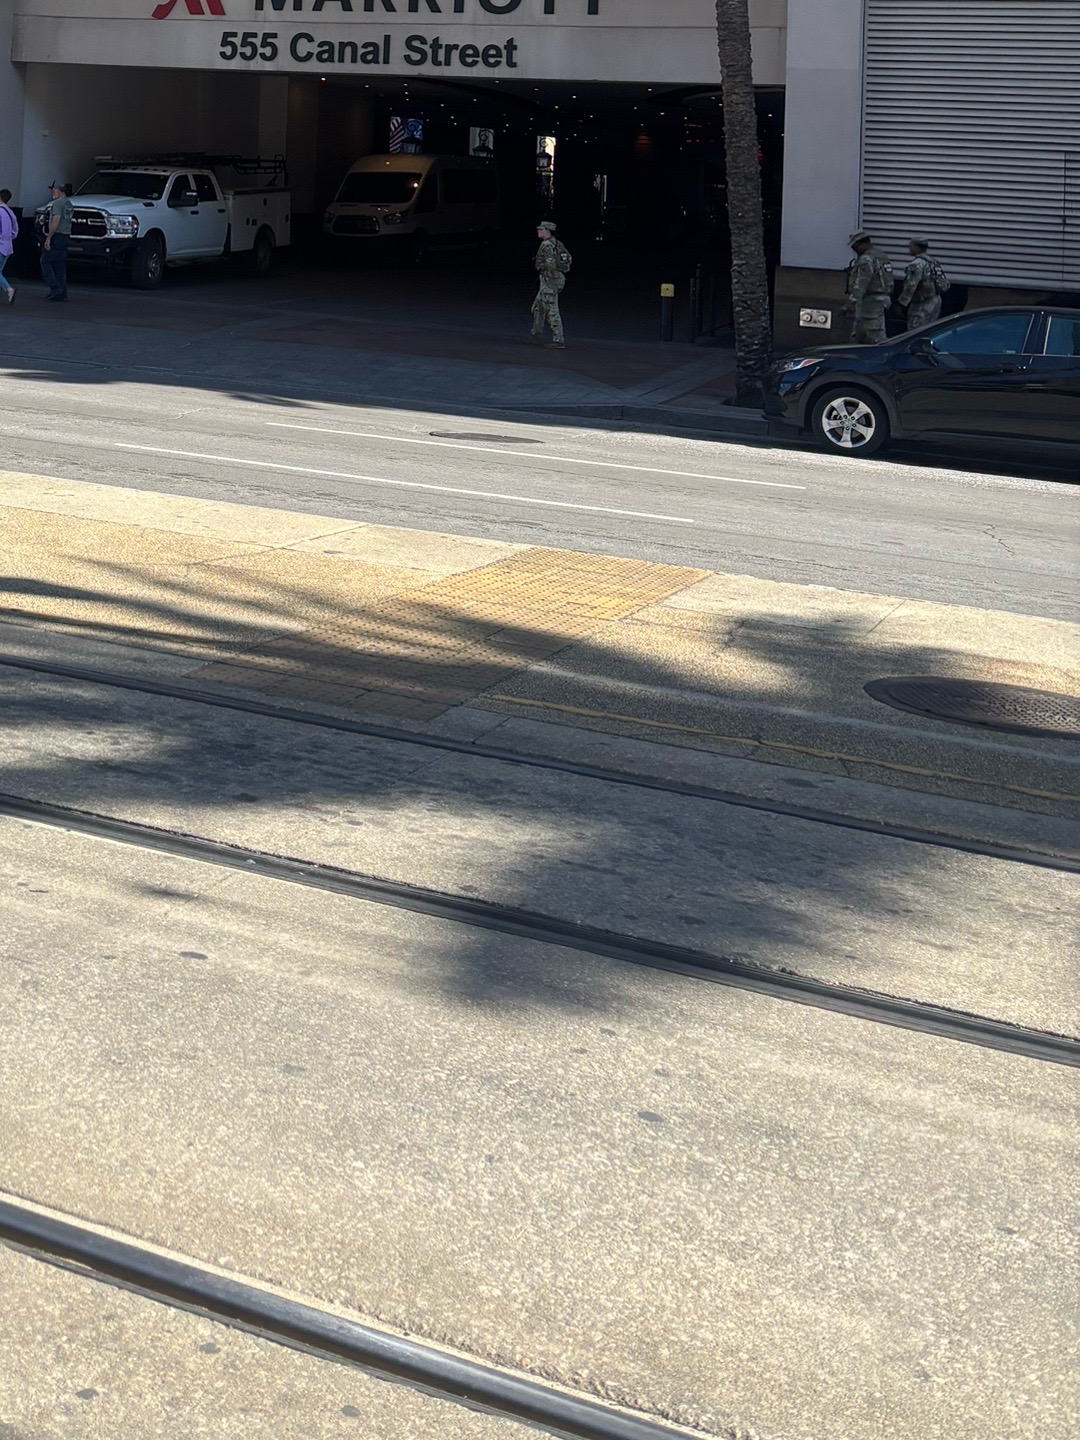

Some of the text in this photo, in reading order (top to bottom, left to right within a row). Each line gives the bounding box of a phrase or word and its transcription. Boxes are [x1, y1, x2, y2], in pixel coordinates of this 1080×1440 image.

[219, 31, 518, 68] 555 Canal Street
